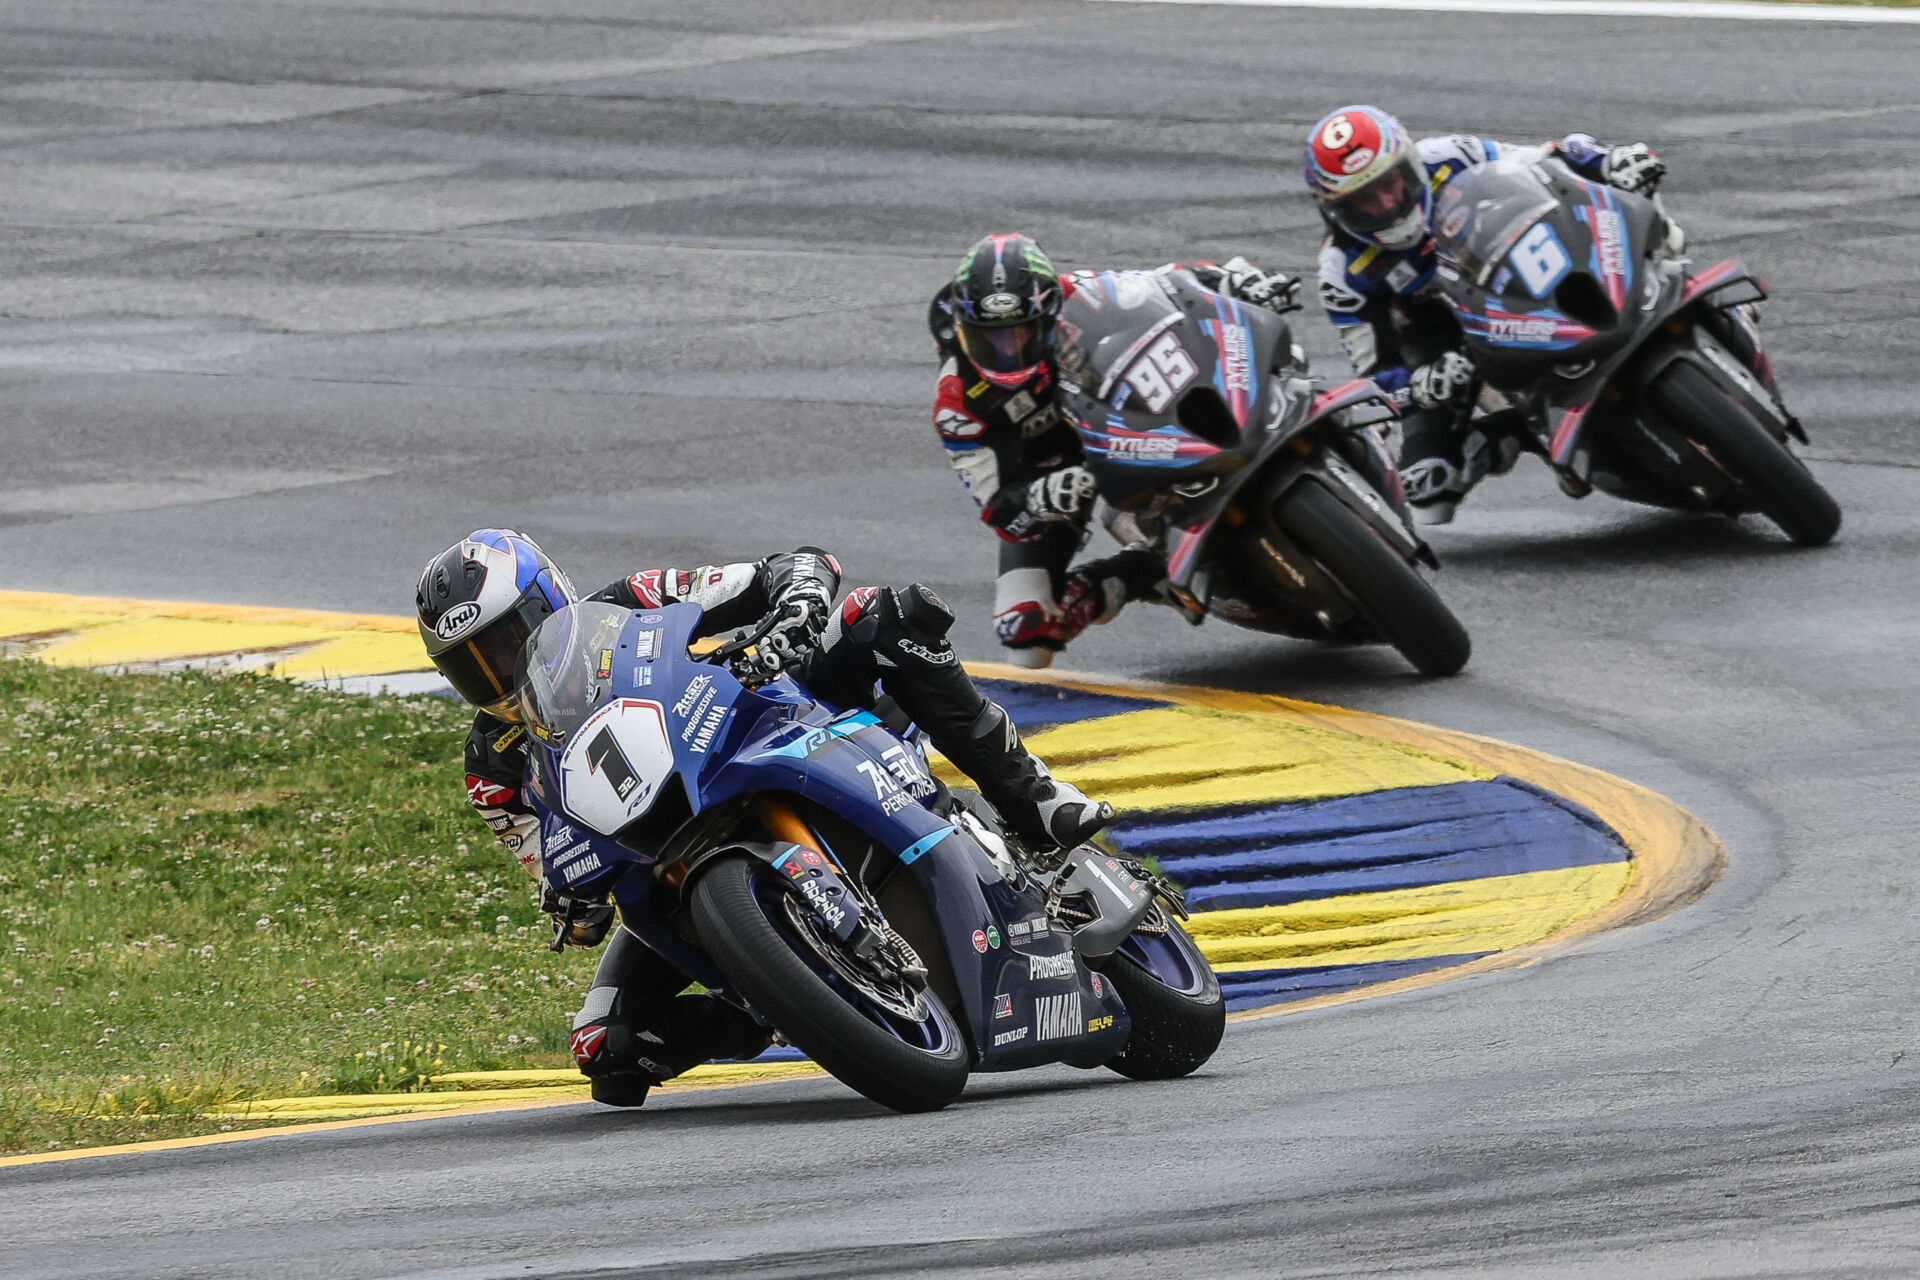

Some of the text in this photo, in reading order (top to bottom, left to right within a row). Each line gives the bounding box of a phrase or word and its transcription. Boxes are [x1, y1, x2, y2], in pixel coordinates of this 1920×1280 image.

[1322, 115, 1353, 149] 6
[1508, 221, 1573, 300] 6
[1124, 331, 1199, 414] 95
[1108, 437, 1179, 452] TYTLERS
[440, 604, 475, 638] Arai
[672, 674, 713, 716] Attack
[681, 686, 718, 742] PROGRESSIVE
[570, 706, 612, 751] MOTOAMERICA
[689, 705, 728, 753] YAMAHA
[586, 723, 643, 805] 1
[618, 776, 636, 798] 32
[545, 825, 573, 853] Attack
[553, 840, 591, 869] PROGRESSIVE
[563, 852, 601, 883] YAMAHA
[801, 879, 845, 929] DUNLOP
[1029, 950, 1077, 981] PROGRESSIVE
[1035, 991, 1083, 1042] YAMAHA
[994, 1026, 1028, 1047] DUNLOP
